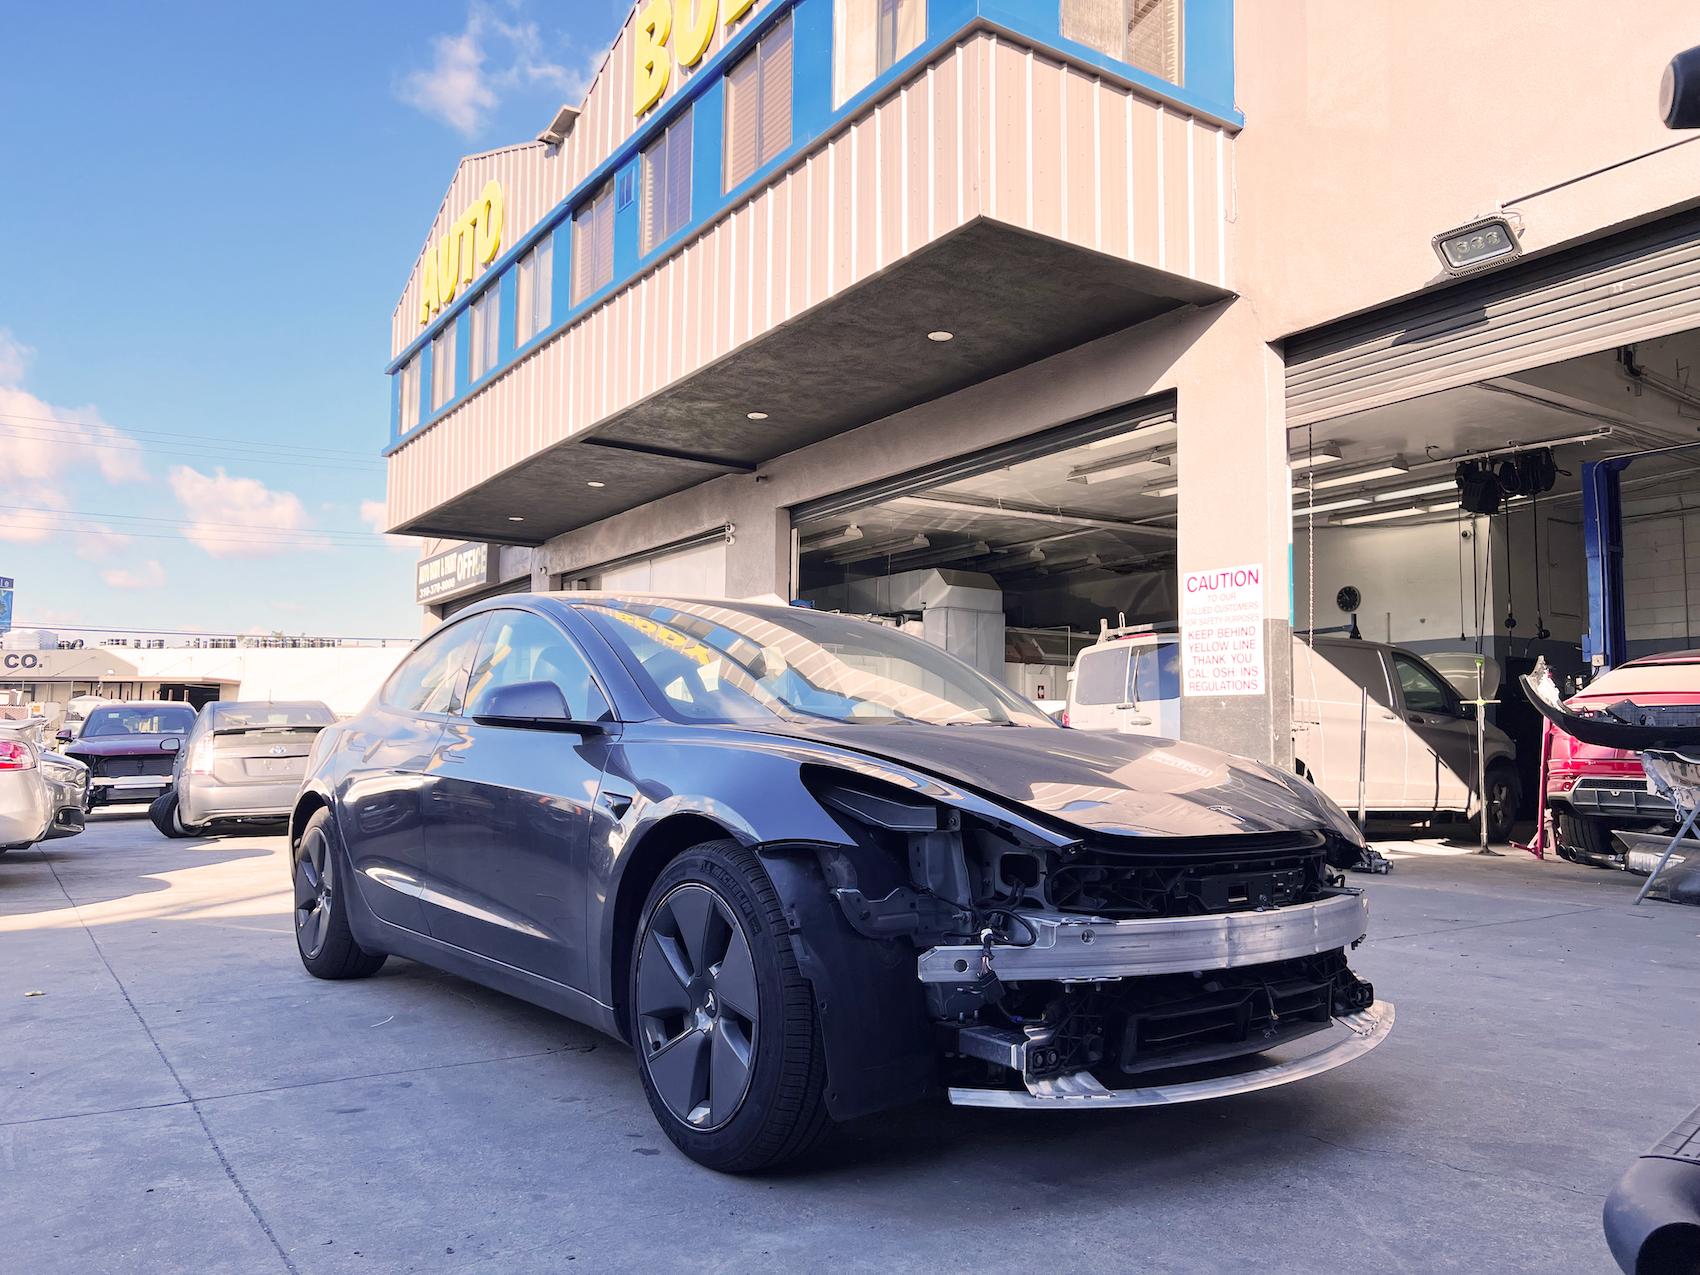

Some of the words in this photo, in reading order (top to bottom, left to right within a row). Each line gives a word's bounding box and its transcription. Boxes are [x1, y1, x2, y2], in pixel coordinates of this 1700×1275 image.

[420, 179, 503, 324] AUTO
[457, 545, 486, 581] OFFICE
[1187, 569, 1259, 592] CAUTION
[1208, 594, 1218, 602] TO
[1219, 592, 1236, 601] OUR
[1214, 601, 1259, 613] CUSTOMERS
[1188, 629, 1214, 640] KEEP
[1217, 626, 1256, 638] BEHIND
[1189, 641, 1229, 653] YELLOW
[1233, 639, 1256, 651] LINE
[4, 653, 43, 669] CO.
[1192, 654, 1226, 665] THANK
[1231, 653, 1252, 664] YOU
[1212, 667, 1235, 678] OSH
[1240, 666, 1259, 677] INS
[1189, 679, 1258, 692] REGULATIONS
